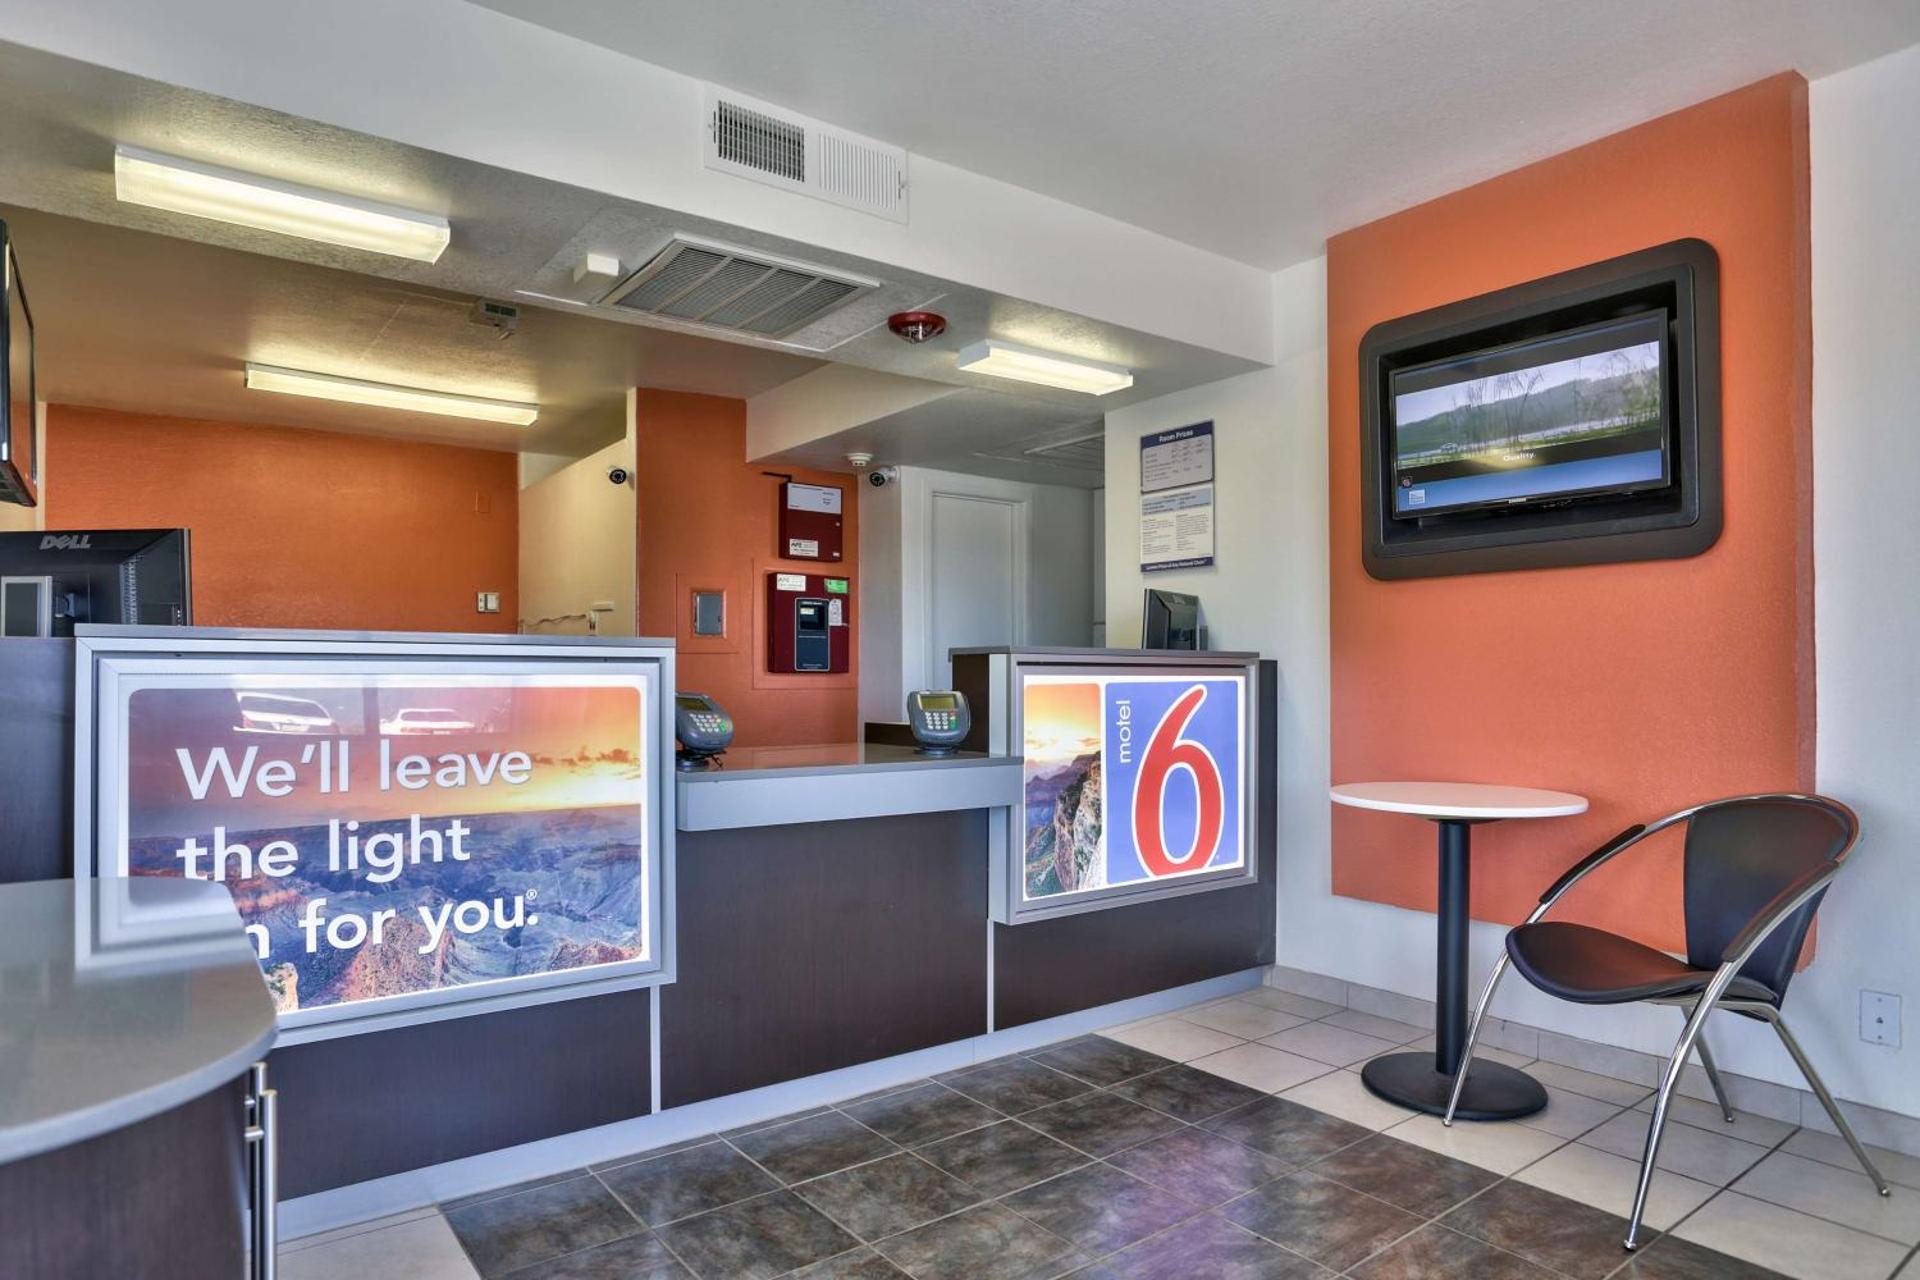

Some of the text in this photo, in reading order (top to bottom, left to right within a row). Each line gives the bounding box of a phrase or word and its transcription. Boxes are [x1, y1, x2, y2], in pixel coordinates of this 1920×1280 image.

[40, 534, 91, 550] DELL
[175, 738, 532, 800] We'll leave
[1115, 684, 1225, 878] motel 6
[176, 813, 471, 883] the light
[245, 922, 271, 960] n
[298, 897, 396, 954] for
